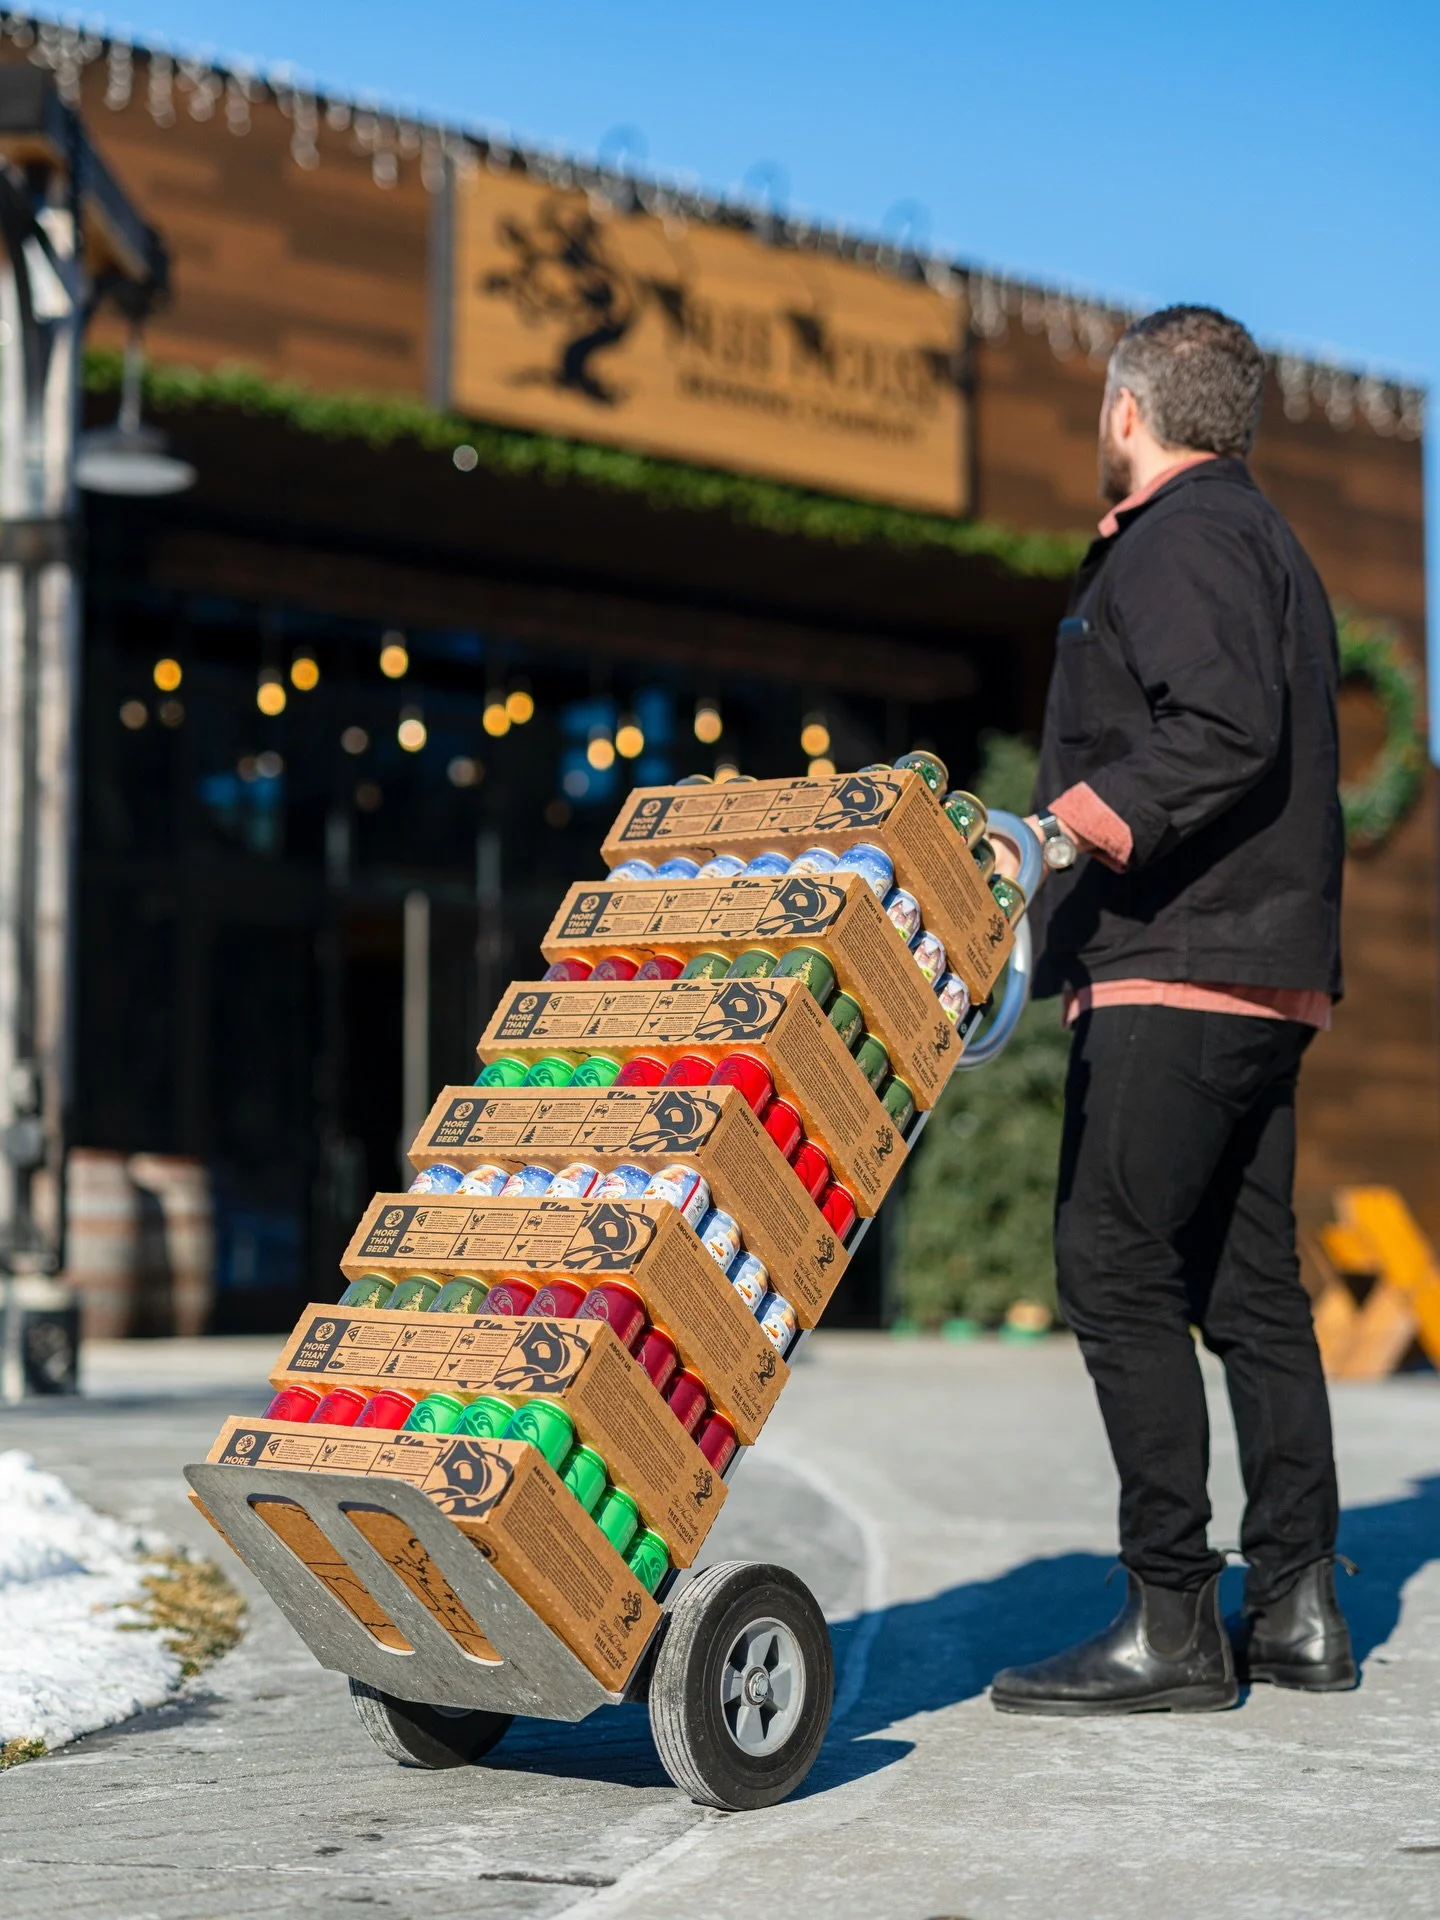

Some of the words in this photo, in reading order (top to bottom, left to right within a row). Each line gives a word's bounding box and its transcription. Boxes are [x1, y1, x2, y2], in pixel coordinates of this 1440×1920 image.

[863, 894, 877, 913] ABOUT
[876, 914, 882, 923] US
[802, 998, 816, 1017] ABOUT
[815, 1018, 821, 1027] US
[443, 1120, 469, 1128] MORE
[739, 1107, 753, 1127] ABOUT
[752, 1128, 759, 1137] US
[853, 1158, 863, 1174] TREE
[862, 1174, 877, 1195] HOUSE
[370, 1237, 395, 1245] THAN
[373, 1229, 400, 1237] MORE
[676, 1222, 692, 1241] ABOUT
[691, 1241, 698, 1251] US
[366, 1245, 389, 1253] BEER
[793, 1269, 804, 1285] TREE
[803, 1284, 818, 1305] HOUSE
[300, 1351, 326, 1360] THAN
[303, 1342, 331, 1351] MORE
[610, 1342, 625, 1361] ABOUT
[624, 1362, 631, 1372] US
[295, 1359, 320, 1368] BEER
[732, 1385, 743, 1402] TREE
[742, 1401, 757, 1422] HOUSE
[224, 1456, 251, 1466] MORE
[533, 1466, 549, 1485] ABOUT
[548, 1485, 556, 1495] US
[668, 1507, 679, 1524] TREE
[679, 1523, 694, 1544] HOUSE
[595, 1633, 606, 1649] TREE
[605, 1648, 622, 1670] HOUSE
